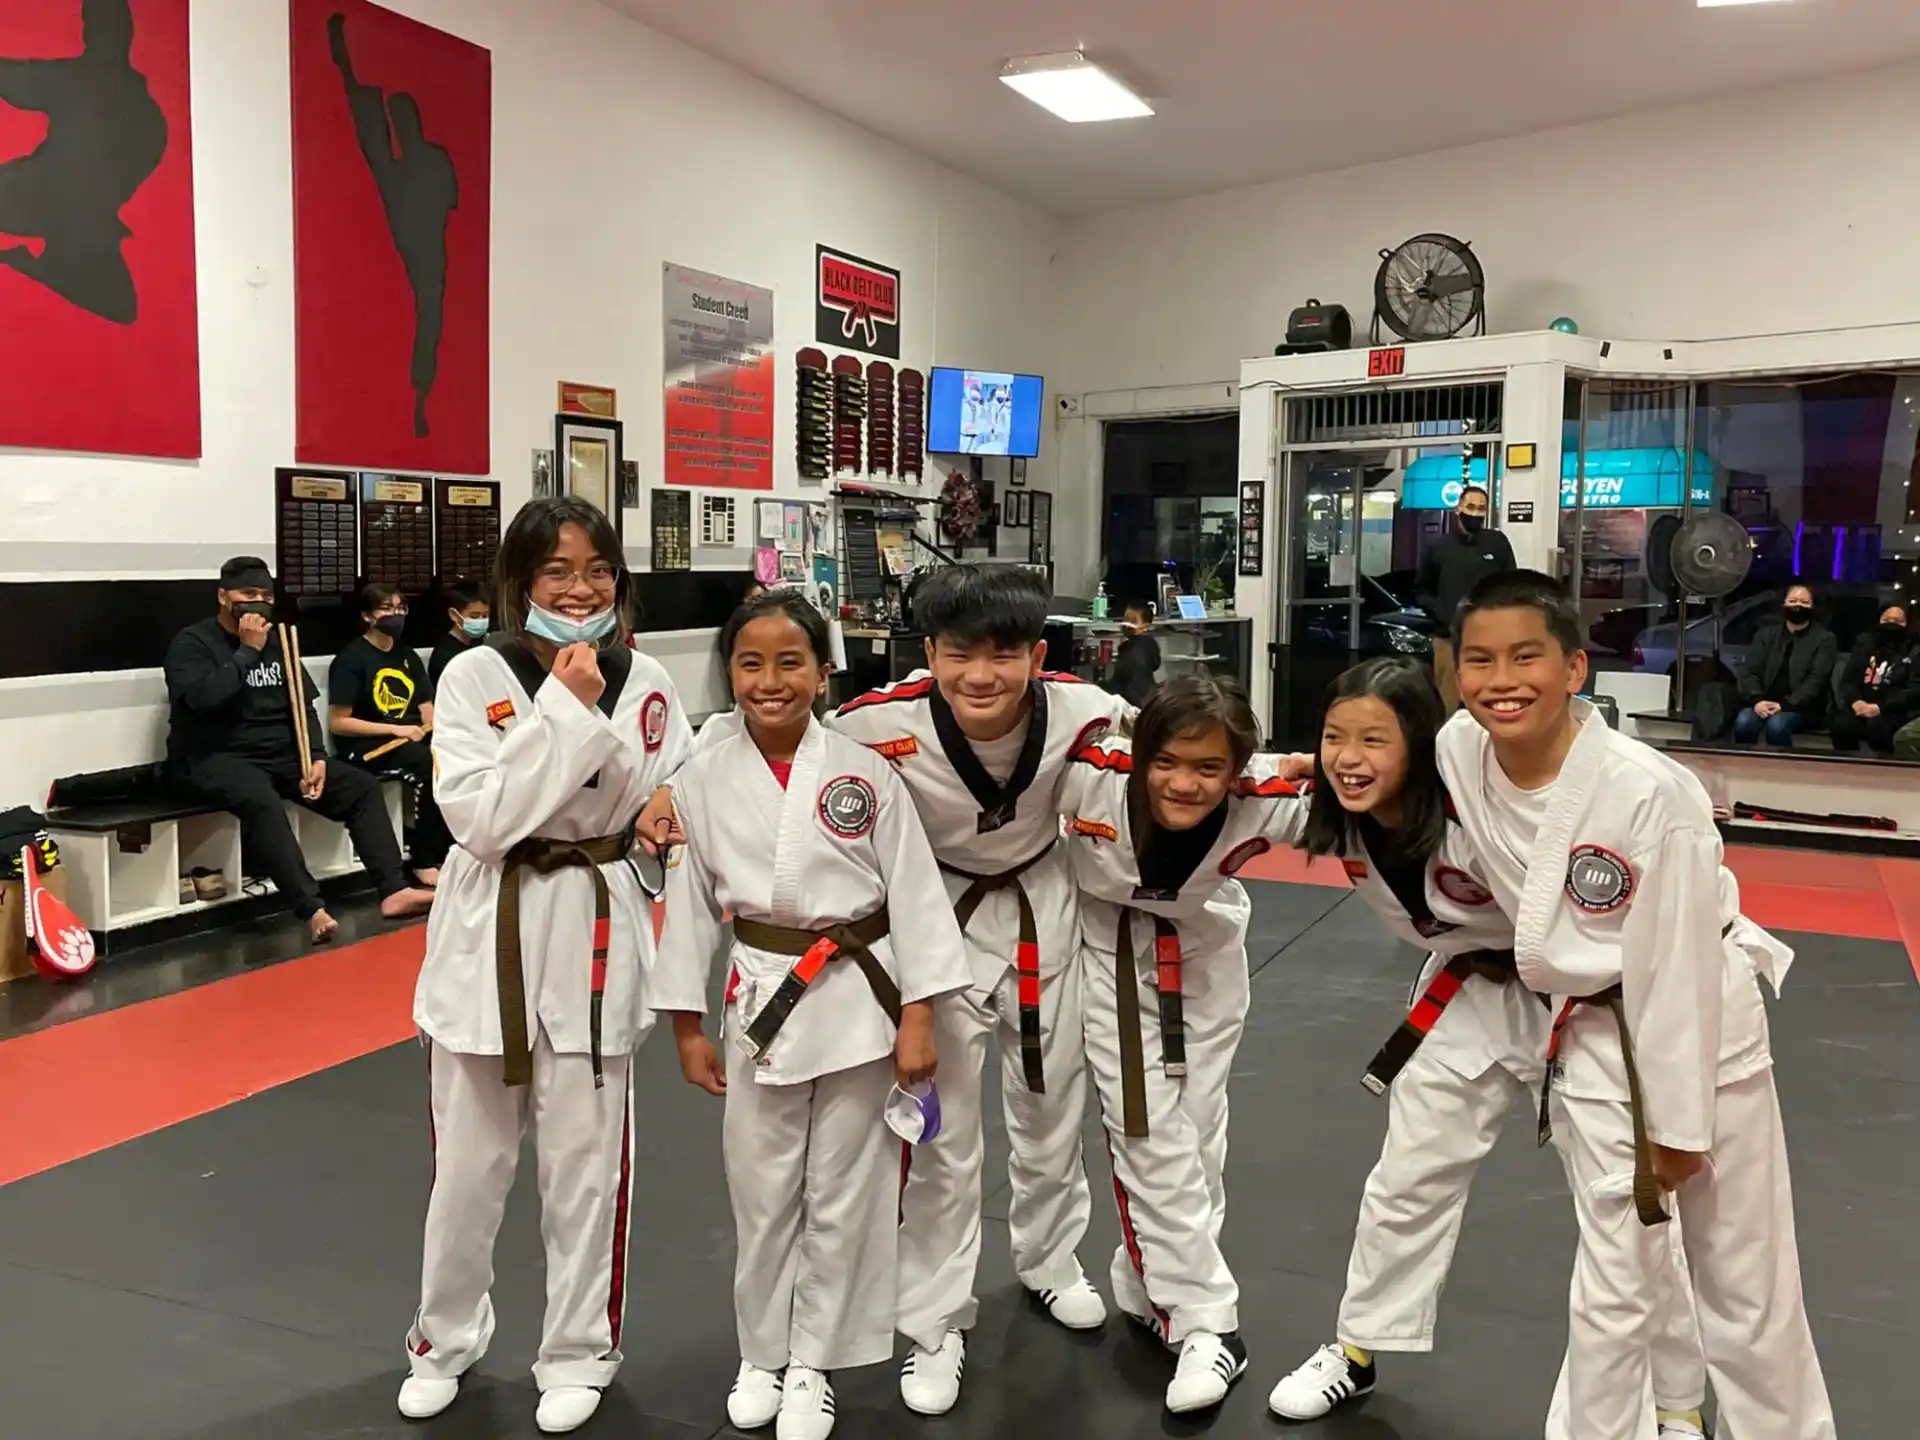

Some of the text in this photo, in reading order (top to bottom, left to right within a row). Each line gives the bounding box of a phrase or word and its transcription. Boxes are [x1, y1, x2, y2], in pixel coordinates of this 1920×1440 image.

[824, 266, 894, 305] BLACK BELT CLUB
[692, 292, 748, 321] Student Creed
[1370, 349, 1405, 375] EXIT
